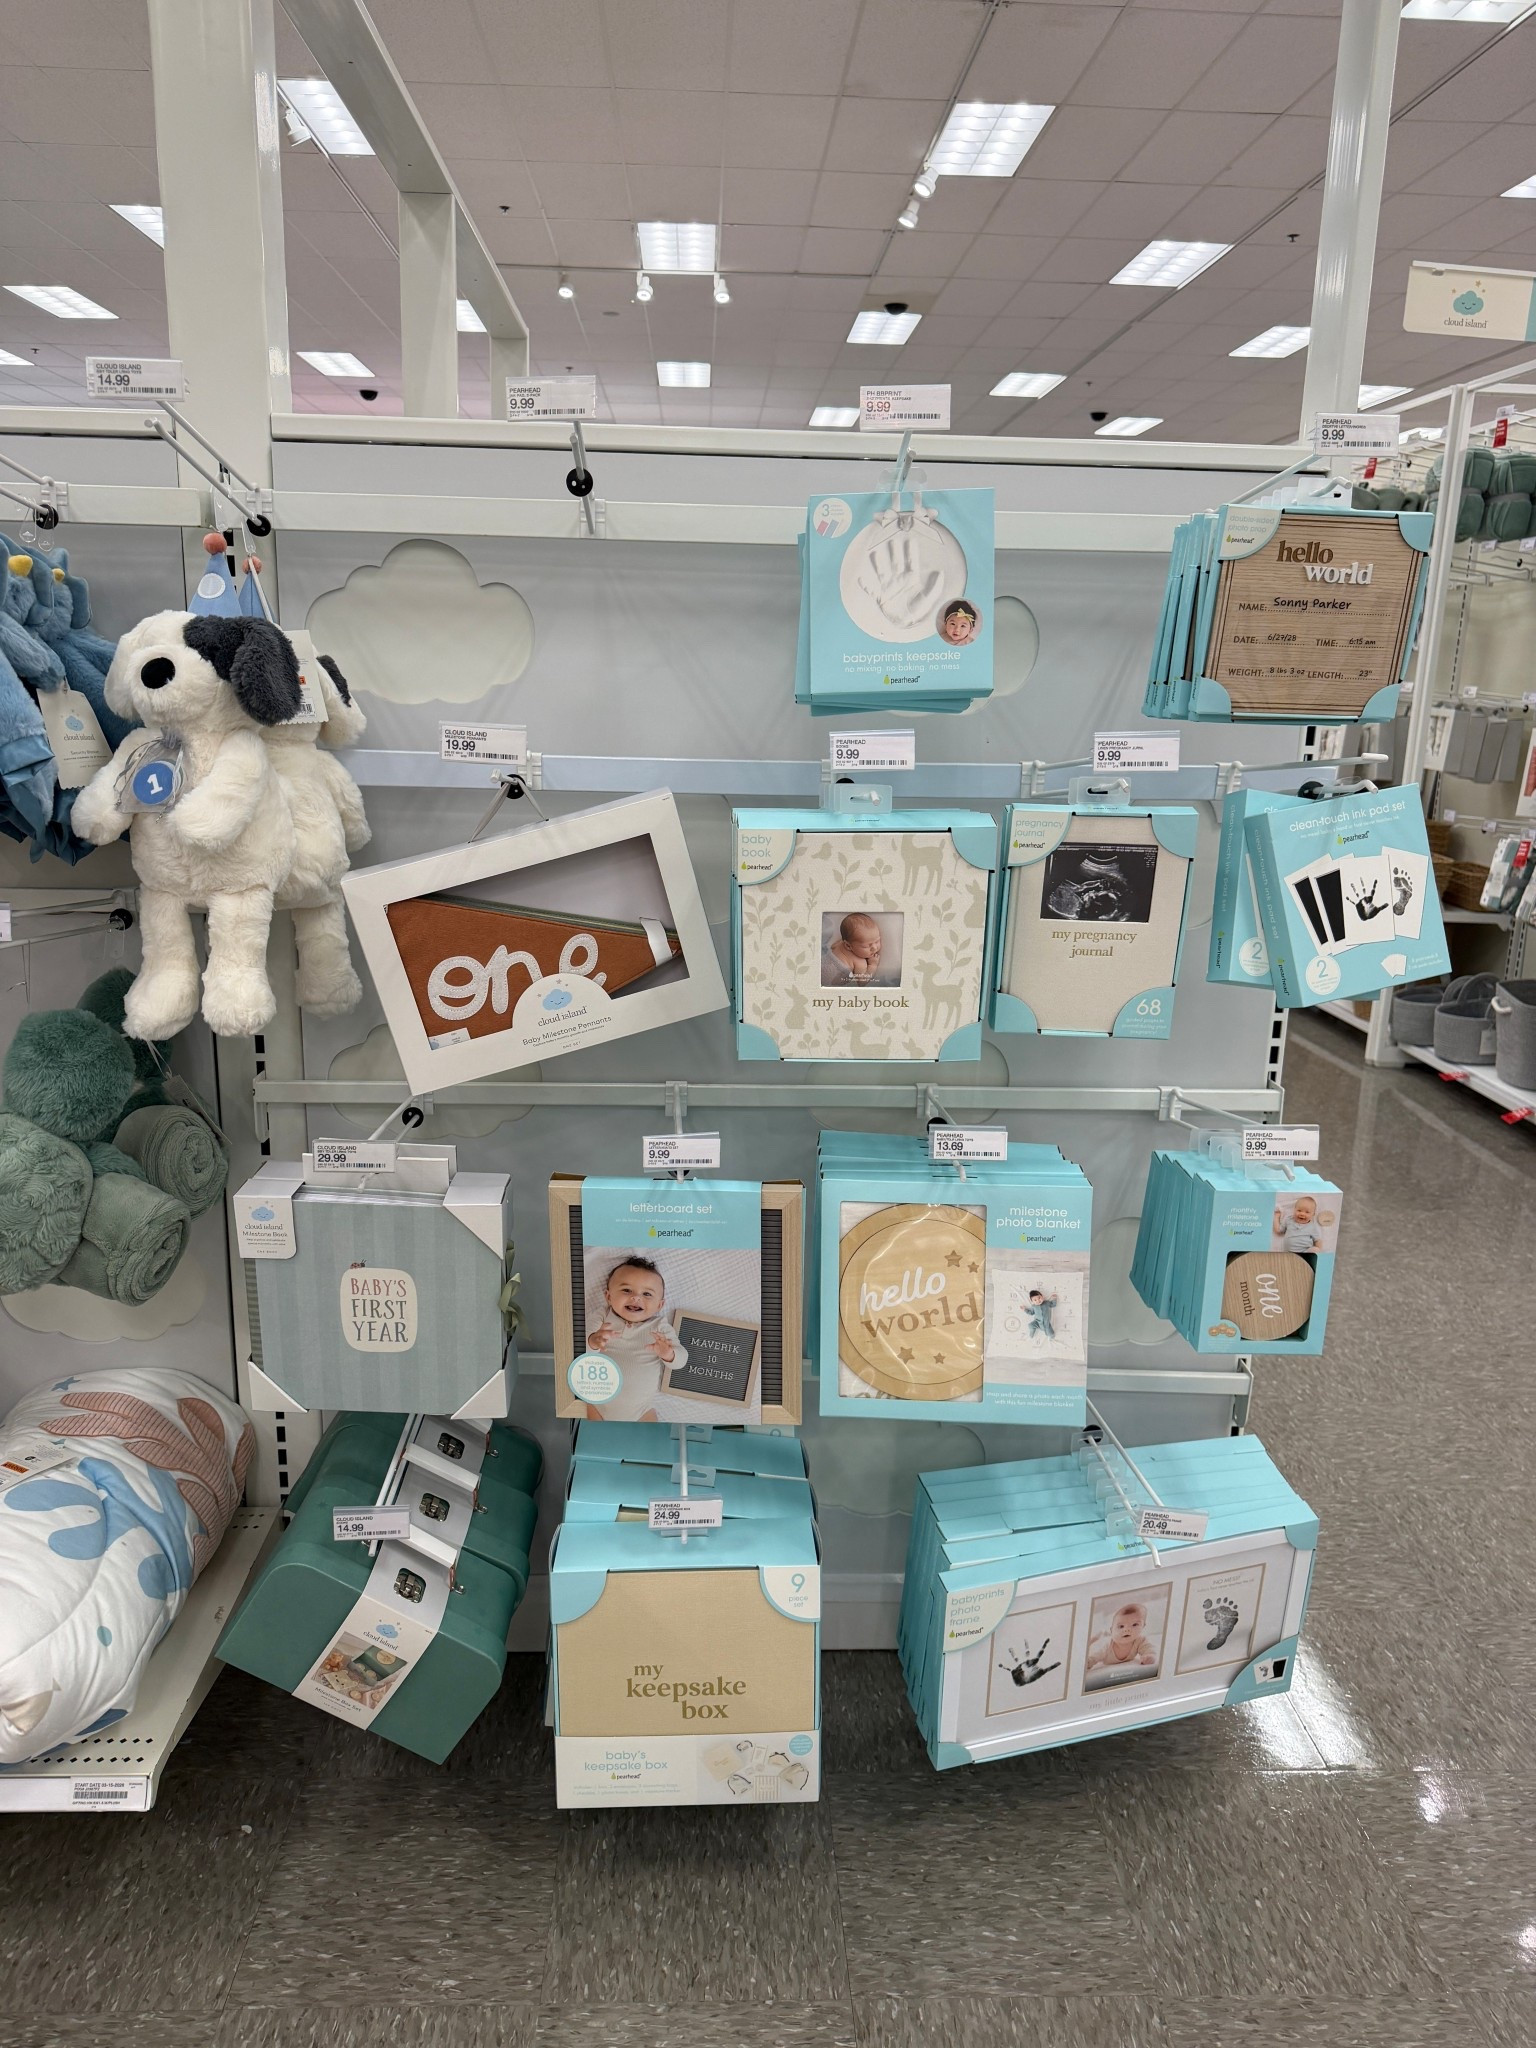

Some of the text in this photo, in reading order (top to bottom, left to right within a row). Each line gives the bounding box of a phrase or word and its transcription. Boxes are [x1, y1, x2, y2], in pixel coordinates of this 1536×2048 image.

[1444, 317, 1487, 328] cloud island
[98, 374, 130, 386] 14.99
[510, 398, 534, 410] 9.99
[866, 401, 890, 412] 9.99
[1322, 429, 1344, 440] 9.99
[822, 504, 830, 517] 3
[1230, 514, 1275, 525] double-sided
[1228, 525, 1267, 534] photo prop
[1230, 536, 1254, 544] pearhead
[1276, 540, 1334, 564] hello
[1304, 562, 1374, 585] world
[1238, 597, 1352, 611] NAME: Sonny Parker
[1233, 636, 1258, 644] DATE:
[1267, 634, 1297, 642] 6/27/28
[1316, 638, 1338, 647] TIME:
[843, 650, 961, 665] babyprints keepsake
[856, 665, 882, 673] mixing
[898, 662, 924, 672] baking
[1228, 668, 1264, 677] WEIGHT:
[1307, 671, 1344, 680] LENGTH:
[890, 676, 920, 685] pearhead
[446, 739, 476, 751] 19.99
[836, 749, 860, 759] 9.99
[1098, 750, 1121, 761] 9.99
[147, 774, 163, 794] 1
[1289, 812, 1350, 832] clean-touch
[1352, 809, 1367, 818] ink
[1369, 803, 1390, 818] pad
[1392, 800, 1406, 812] set
[1015, 819, 1064, 830] pregnancy
[1014, 828, 1046, 838] journal
[1342, 830, 1370, 844] pearhead
[742, 834, 772, 846] baby
[1018, 840, 1046, 850] pearhead
[742, 848, 772, 858] book
[1052, 930, 1138, 943] my pregnancy
[1069, 946, 1114, 958] journal
[1252, 942, 1262, 959] 2
[1316, 960, 1328, 978] 2
[428, 934, 607, 1020] one
[812, 996, 910, 1012] my baby book
[1136, 998, 1161, 1016] 68
[538, 1006, 588, 1027] cloud island
[522, 1036, 542, 1046] Baby
[542, 1026, 576, 1040] Milestone
[578, 1016, 612, 1030] Pennants
[938, 1142, 964, 1151] 13.69
[1246, 1141, 1267, 1150] 9.99
[318, 1154, 346, 1162] 29.99
[648, 1150, 670, 1159] 9.99
[630, 1202, 712, 1214] letterboard set
[1009, 1206, 1068, 1218] milestone
[996, 1217, 1081, 1229] photo blanket
[657, 1229, 694, 1238] pearhead
[1026, 1235, 1056, 1243] pearhead
[350, 1277, 407, 1298] BABY'S
[860, 1266, 946, 1316] hello
[1240, 1281, 1255, 1316] month
[1256, 1273, 1283, 1318] one
[351, 1298, 407, 1320] FIRST
[861, 1292, 982, 1338] world
[352, 1320, 408, 1343] YEAR
[690, 1337, 740, 1354] MAVERIK
[708, 1355, 717, 1363] 10
[578, 1365, 608, 1380] 188
[688, 1365, 734, 1381] MONTHS
[654, 1511, 680, 1519] 24.99
[338, 1524, 364, 1532] 14.99
[1142, 1520, 1168, 1529] 20.49
[791, 1573, 805, 1592] 9
[952, 1589, 1005, 1605] babyprints
[951, 1605, 980, 1617] photo
[950, 1616, 980, 1626] frame
[956, 1627, 984, 1638] pearhead
[363, 1631, 399, 1651] cloud island
[634, 1664, 664, 1680] my
[626, 1676, 747, 1703] keepsake
[682, 1700, 729, 1720] box
[605, 1750, 646, 1761] baby's
[584, 1760, 668, 1772] keepsake box
